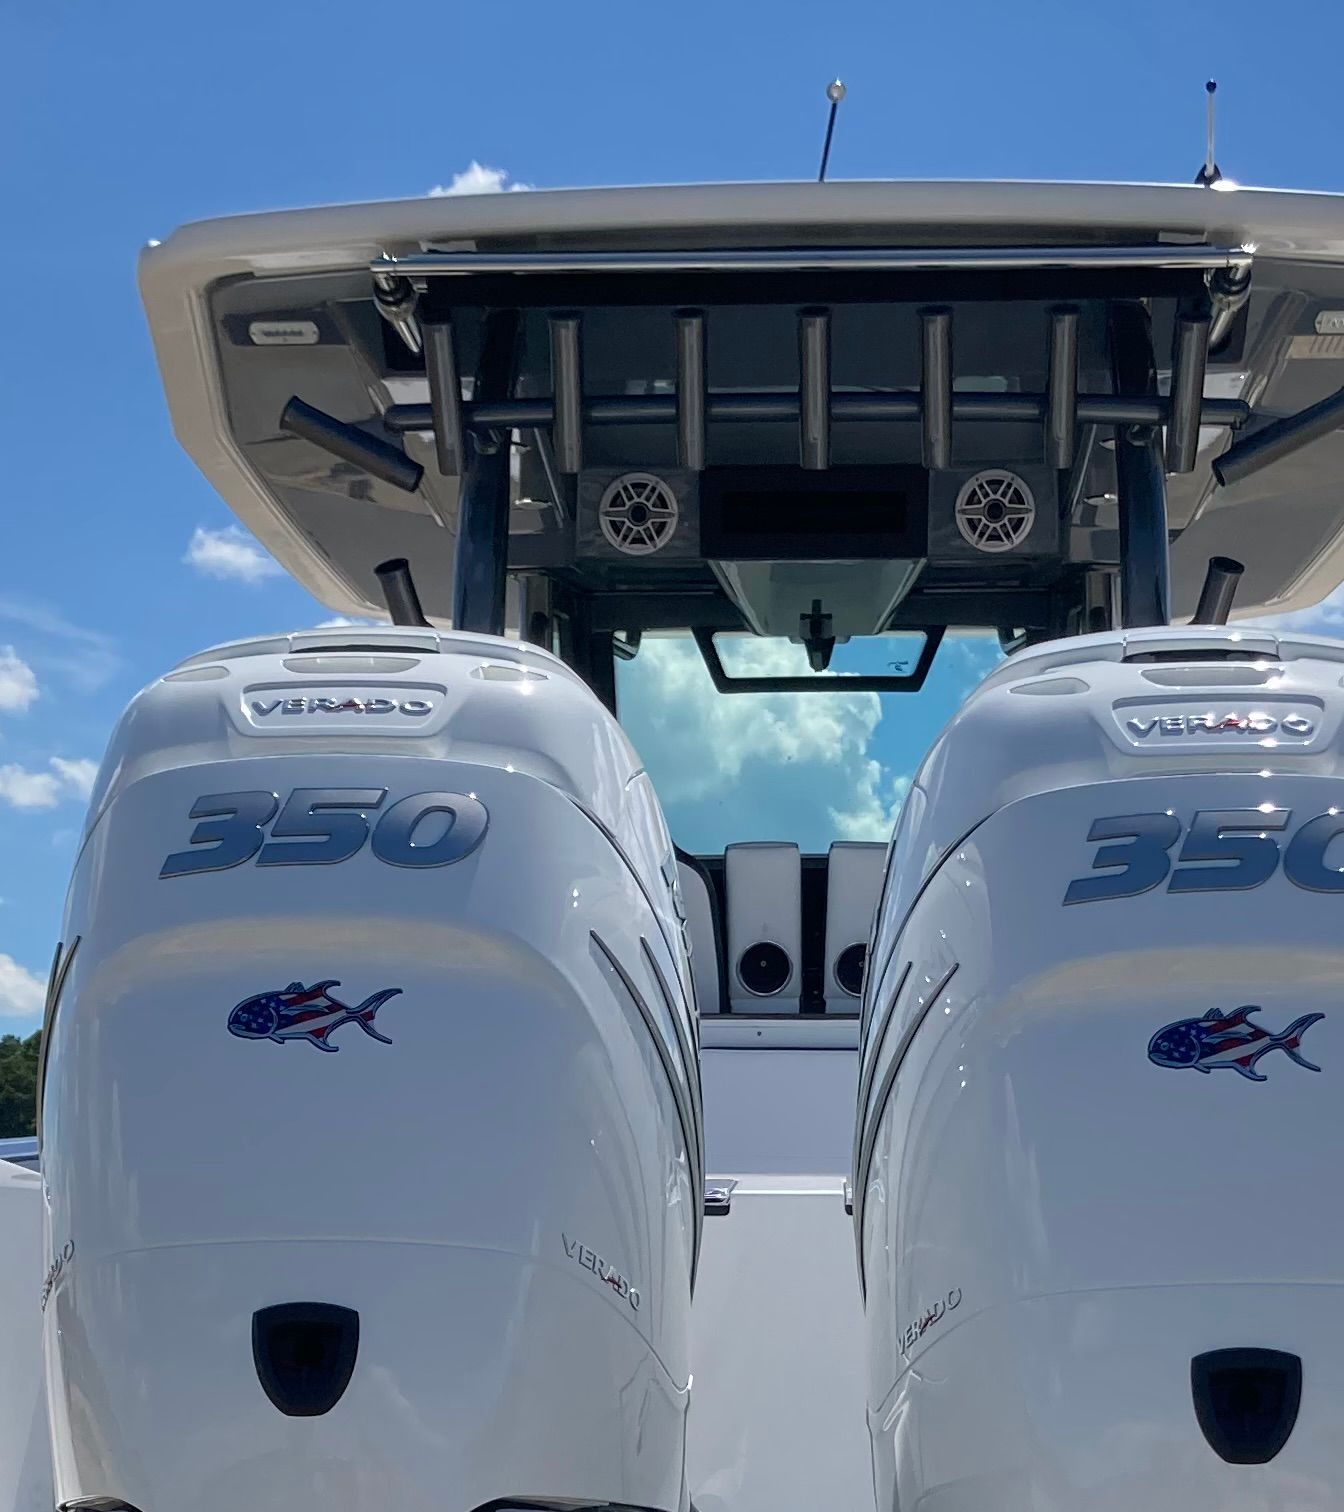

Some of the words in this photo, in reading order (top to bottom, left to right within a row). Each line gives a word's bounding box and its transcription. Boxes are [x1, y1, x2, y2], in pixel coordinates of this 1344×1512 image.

[251, 696, 435, 717] VERADO
[1126, 713, 1315, 739] VERADO
[158, 787, 491, 881] 350
[561, 1231, 641, 1313] VERADO
[898, 1286, 963, 1357] VERADO
